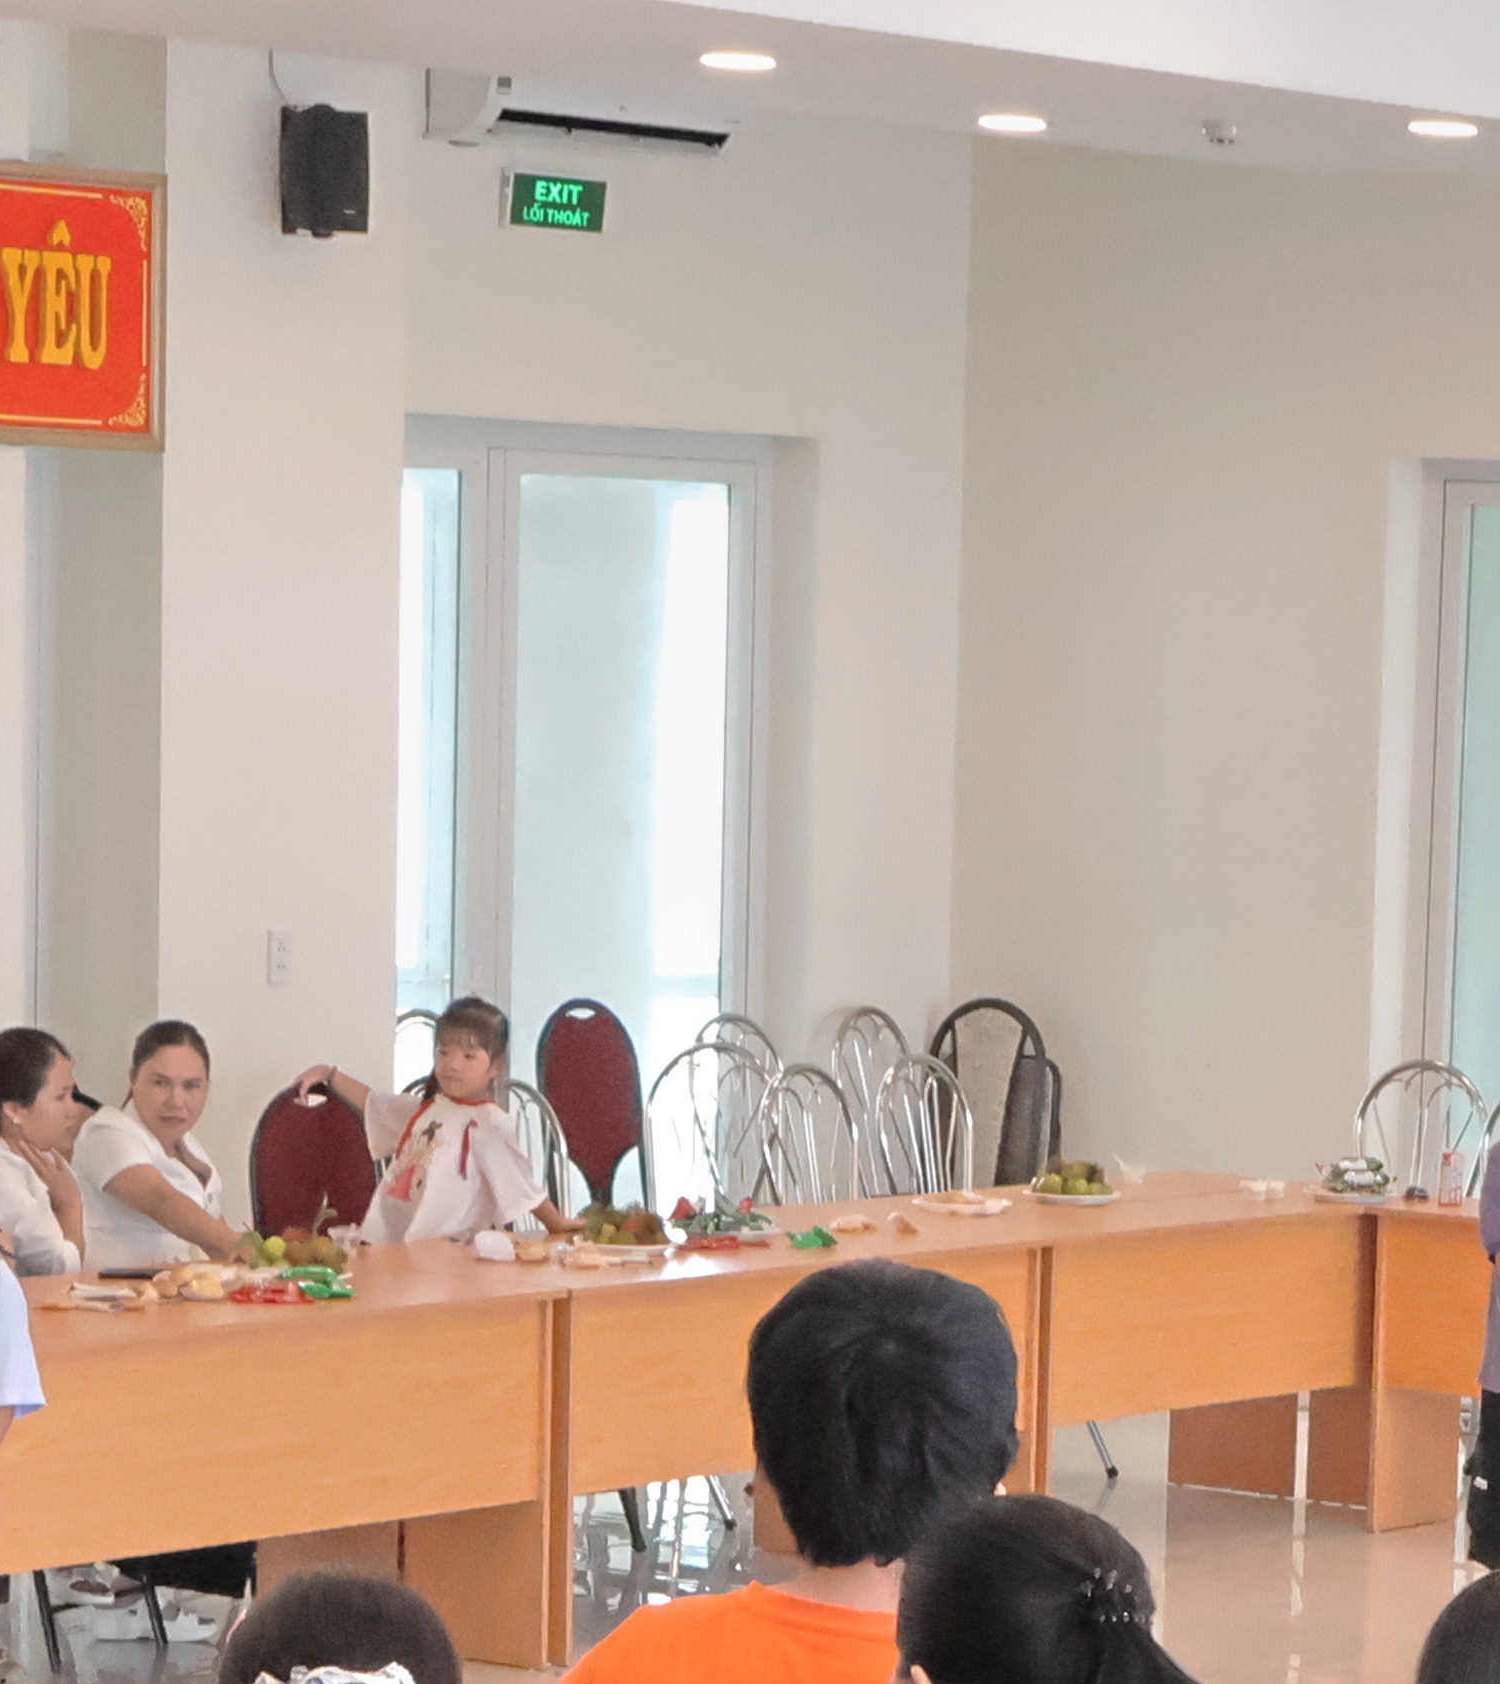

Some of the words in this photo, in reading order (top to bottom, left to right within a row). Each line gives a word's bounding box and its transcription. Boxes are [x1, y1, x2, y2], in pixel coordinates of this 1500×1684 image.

[534, 180, 583, 205] EXIT
[546, 207, 590, 227] THOÁT
[0, 220, 112, 370] YÊU
